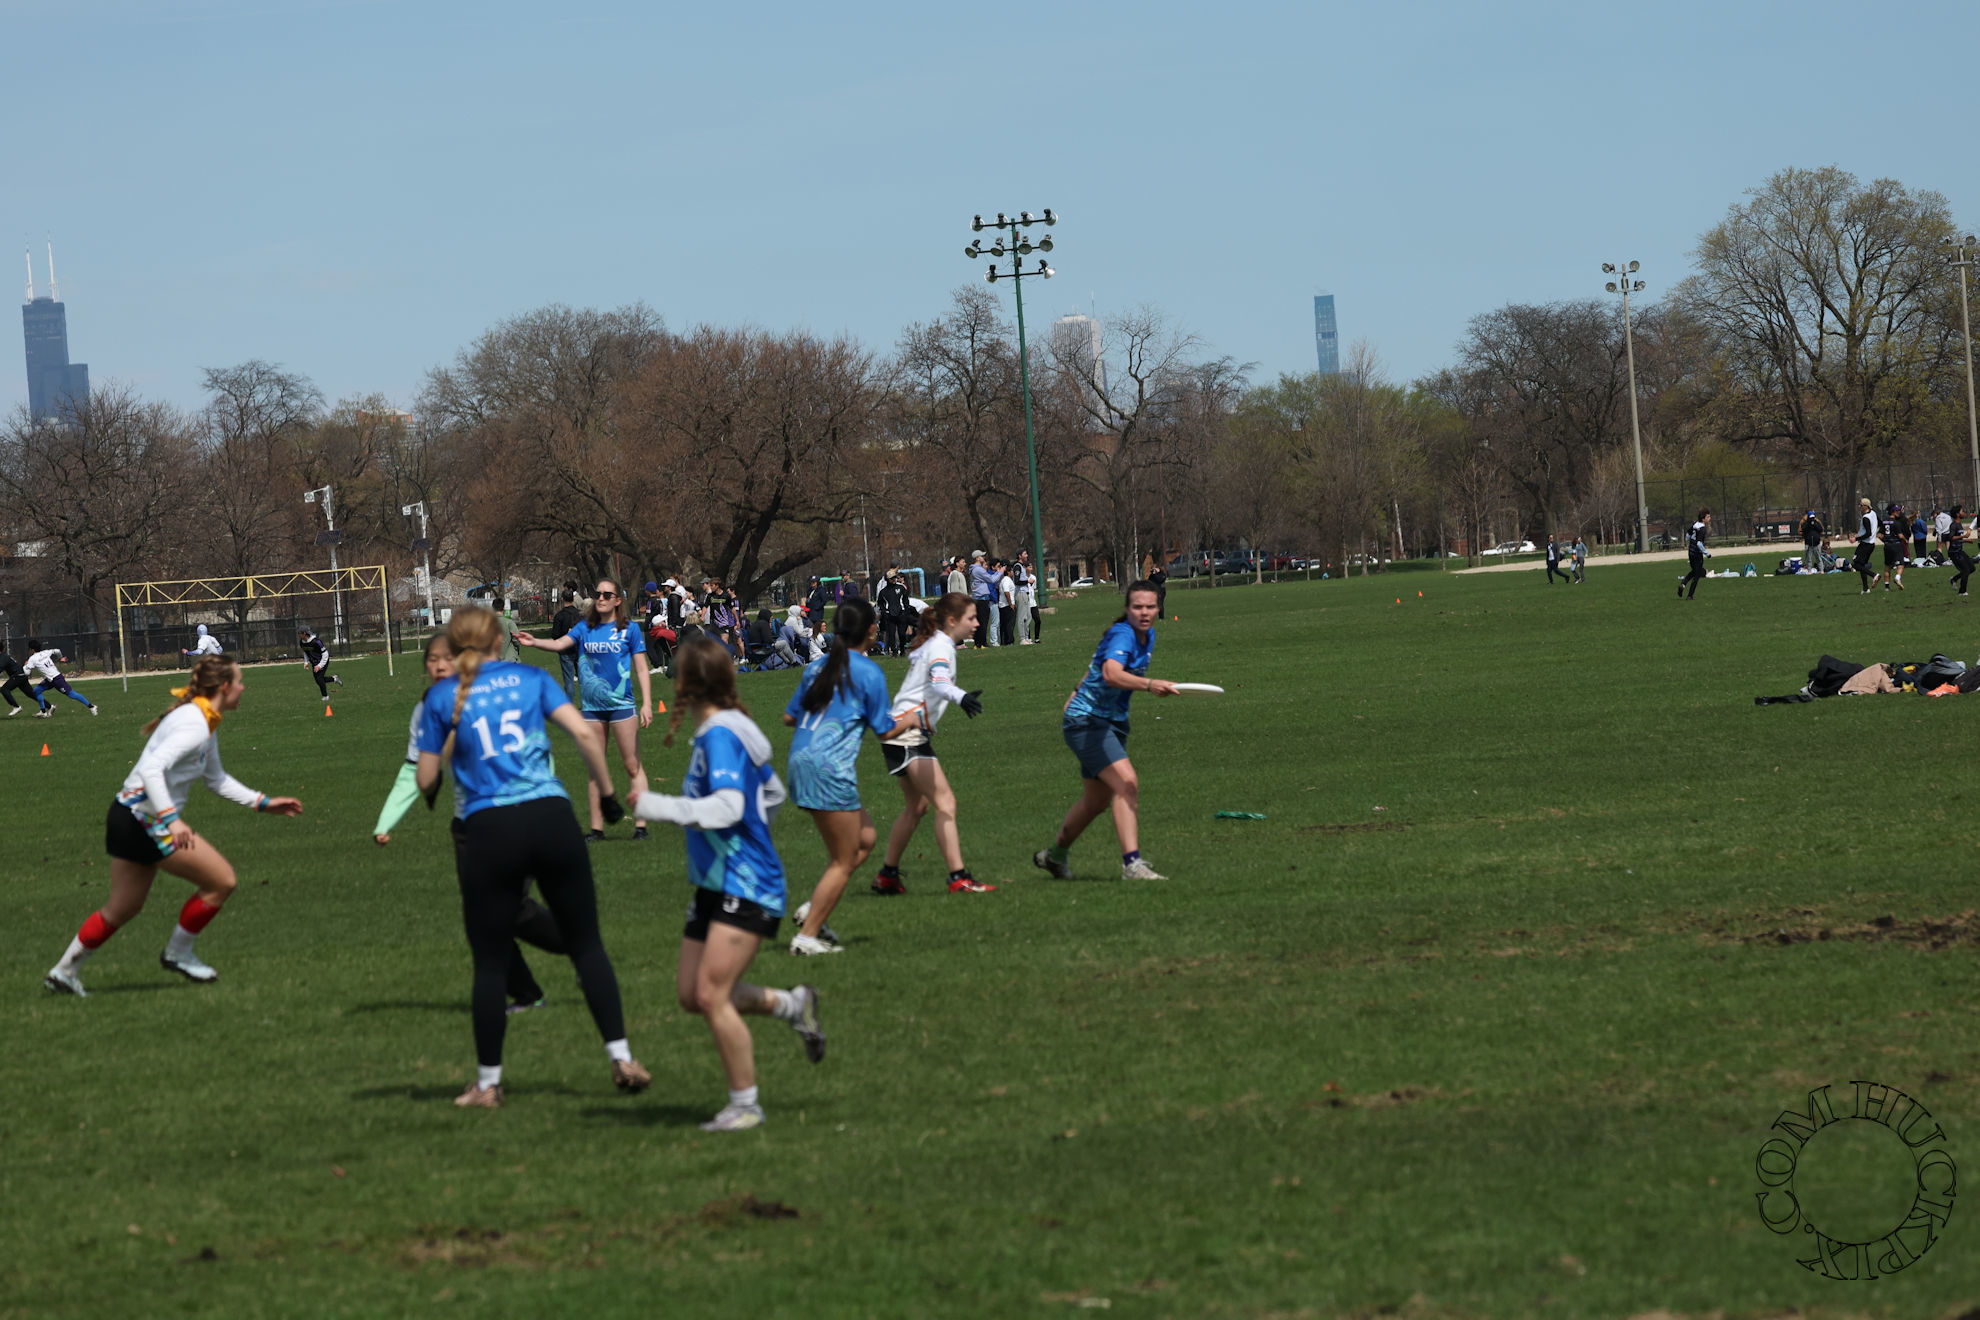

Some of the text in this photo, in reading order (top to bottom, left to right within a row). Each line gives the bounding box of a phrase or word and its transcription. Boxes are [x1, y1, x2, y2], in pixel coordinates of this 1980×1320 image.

[609, 627, 628, 642] 21
[583, 641, 622, 654] SIRENS
[471, 709, 526, 761] 15
